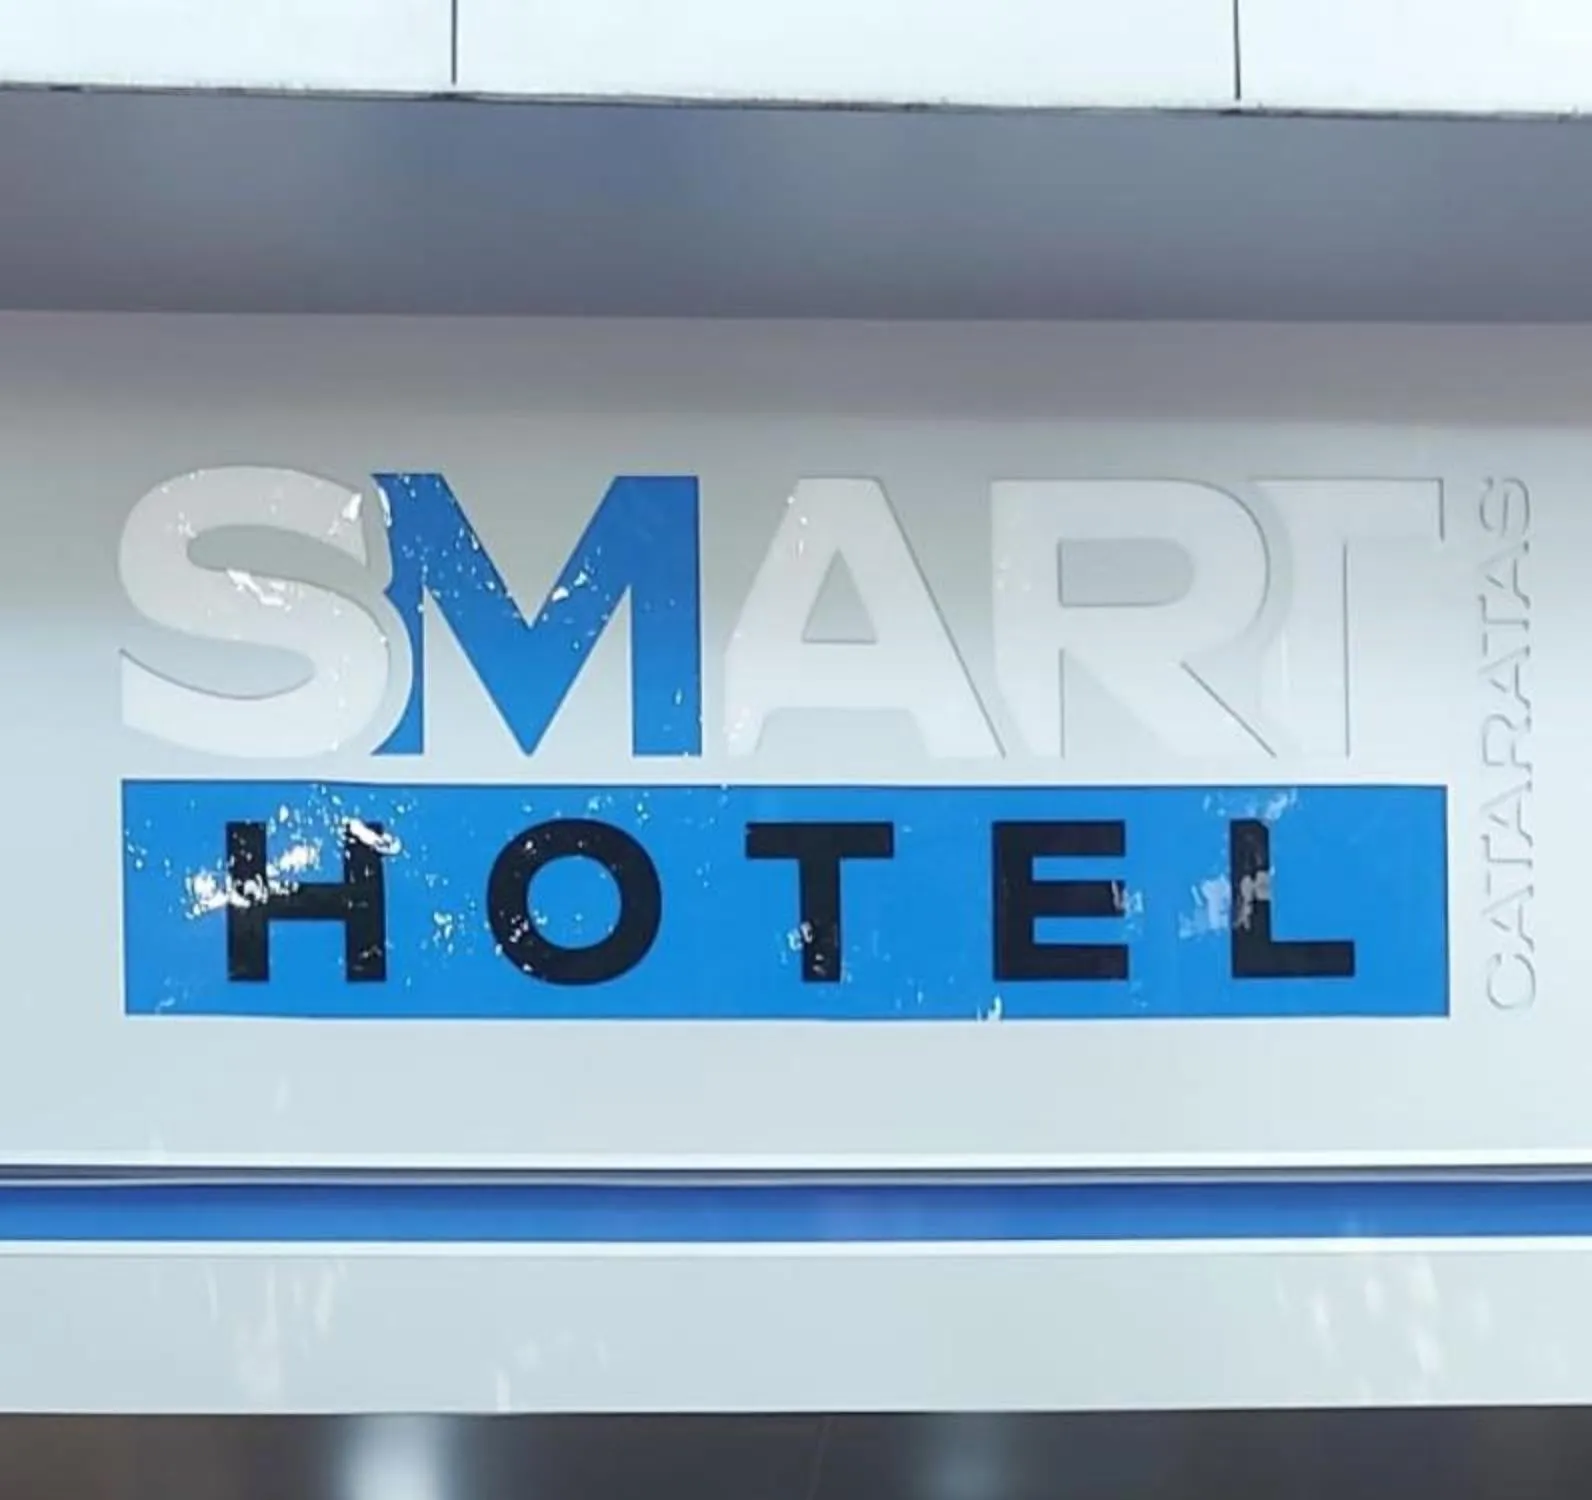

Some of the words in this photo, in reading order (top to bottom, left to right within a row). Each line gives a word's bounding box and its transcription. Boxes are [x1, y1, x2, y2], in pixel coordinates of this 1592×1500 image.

[119, 465, 1445, 758] SMART
[1478, 475, 1537, 1011] CATARATAS
[225, 817, 1356, 985] HOTEL
